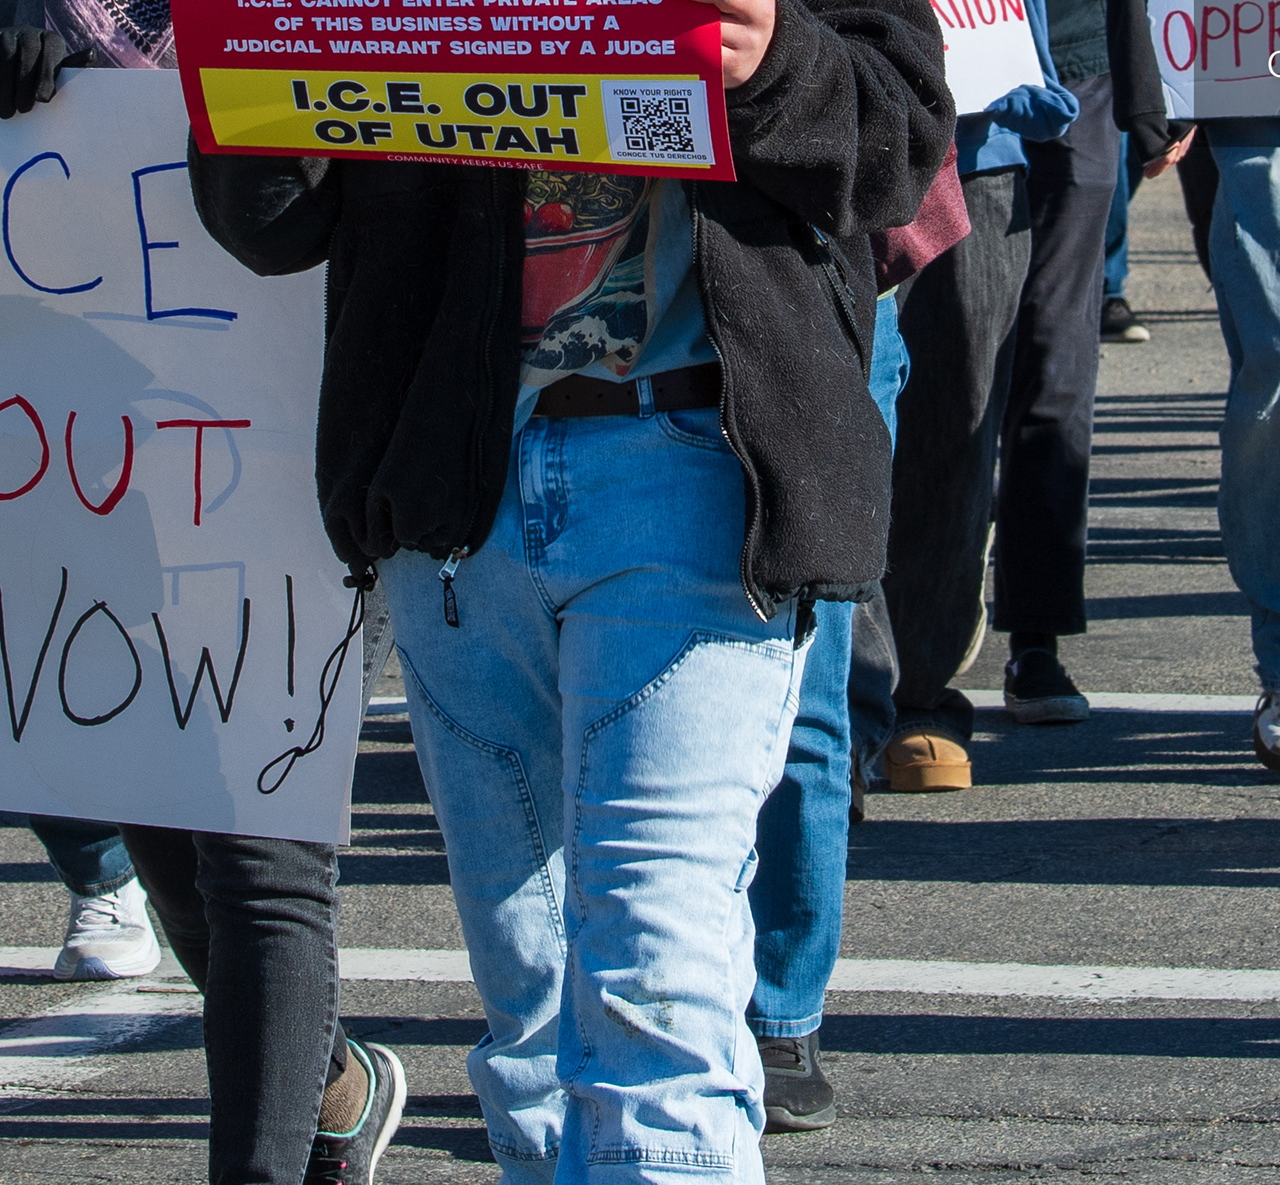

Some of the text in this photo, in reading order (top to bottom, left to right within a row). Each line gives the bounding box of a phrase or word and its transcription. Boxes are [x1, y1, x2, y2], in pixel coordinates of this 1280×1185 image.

[274, 15, 620, 32] OF THIS BUSINESS WITHOUT A
[223, 39, 676, 56] JUDICIAL WARRANT SIGNED BY A JUDGE
[290, 79, 588, 119] I.C.E. OUT
[613, 88, 693, 97] KNOW YOUR RIGHTS
[314, 118, 582, 156] OF UTAH
[387, 154, 544, 171] COMMUNITY KEEPS US SAFE
[616, 151, 708, 161] CONOCE TUS DERECHOS
